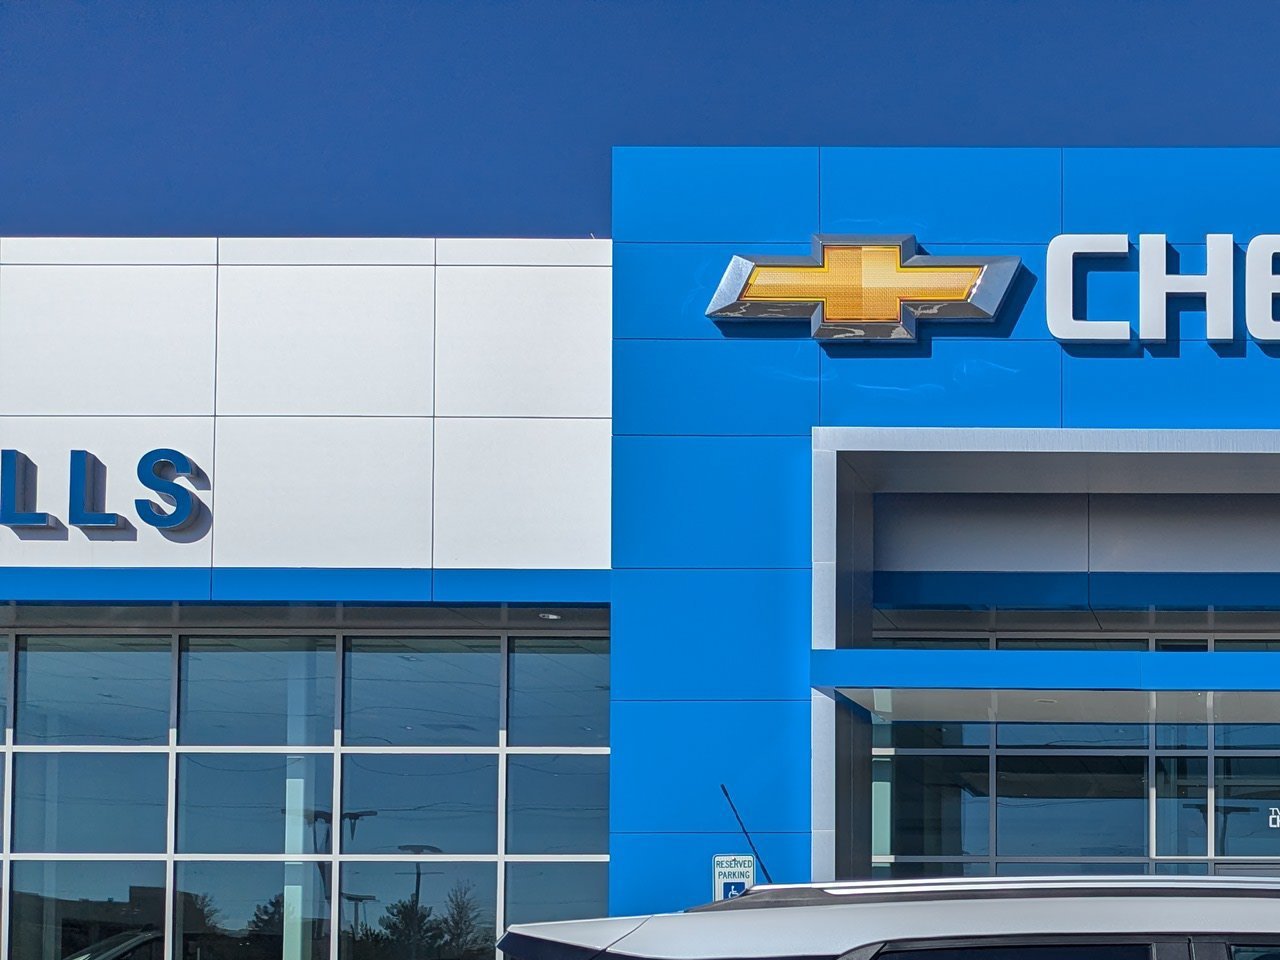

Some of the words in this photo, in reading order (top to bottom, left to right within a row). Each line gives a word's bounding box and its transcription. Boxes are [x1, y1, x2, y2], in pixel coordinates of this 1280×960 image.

[0, 448, 193, 529] LLS
[716, 860, 753, 869] RESERVED
[718, 870, 750, 880] PARKING
